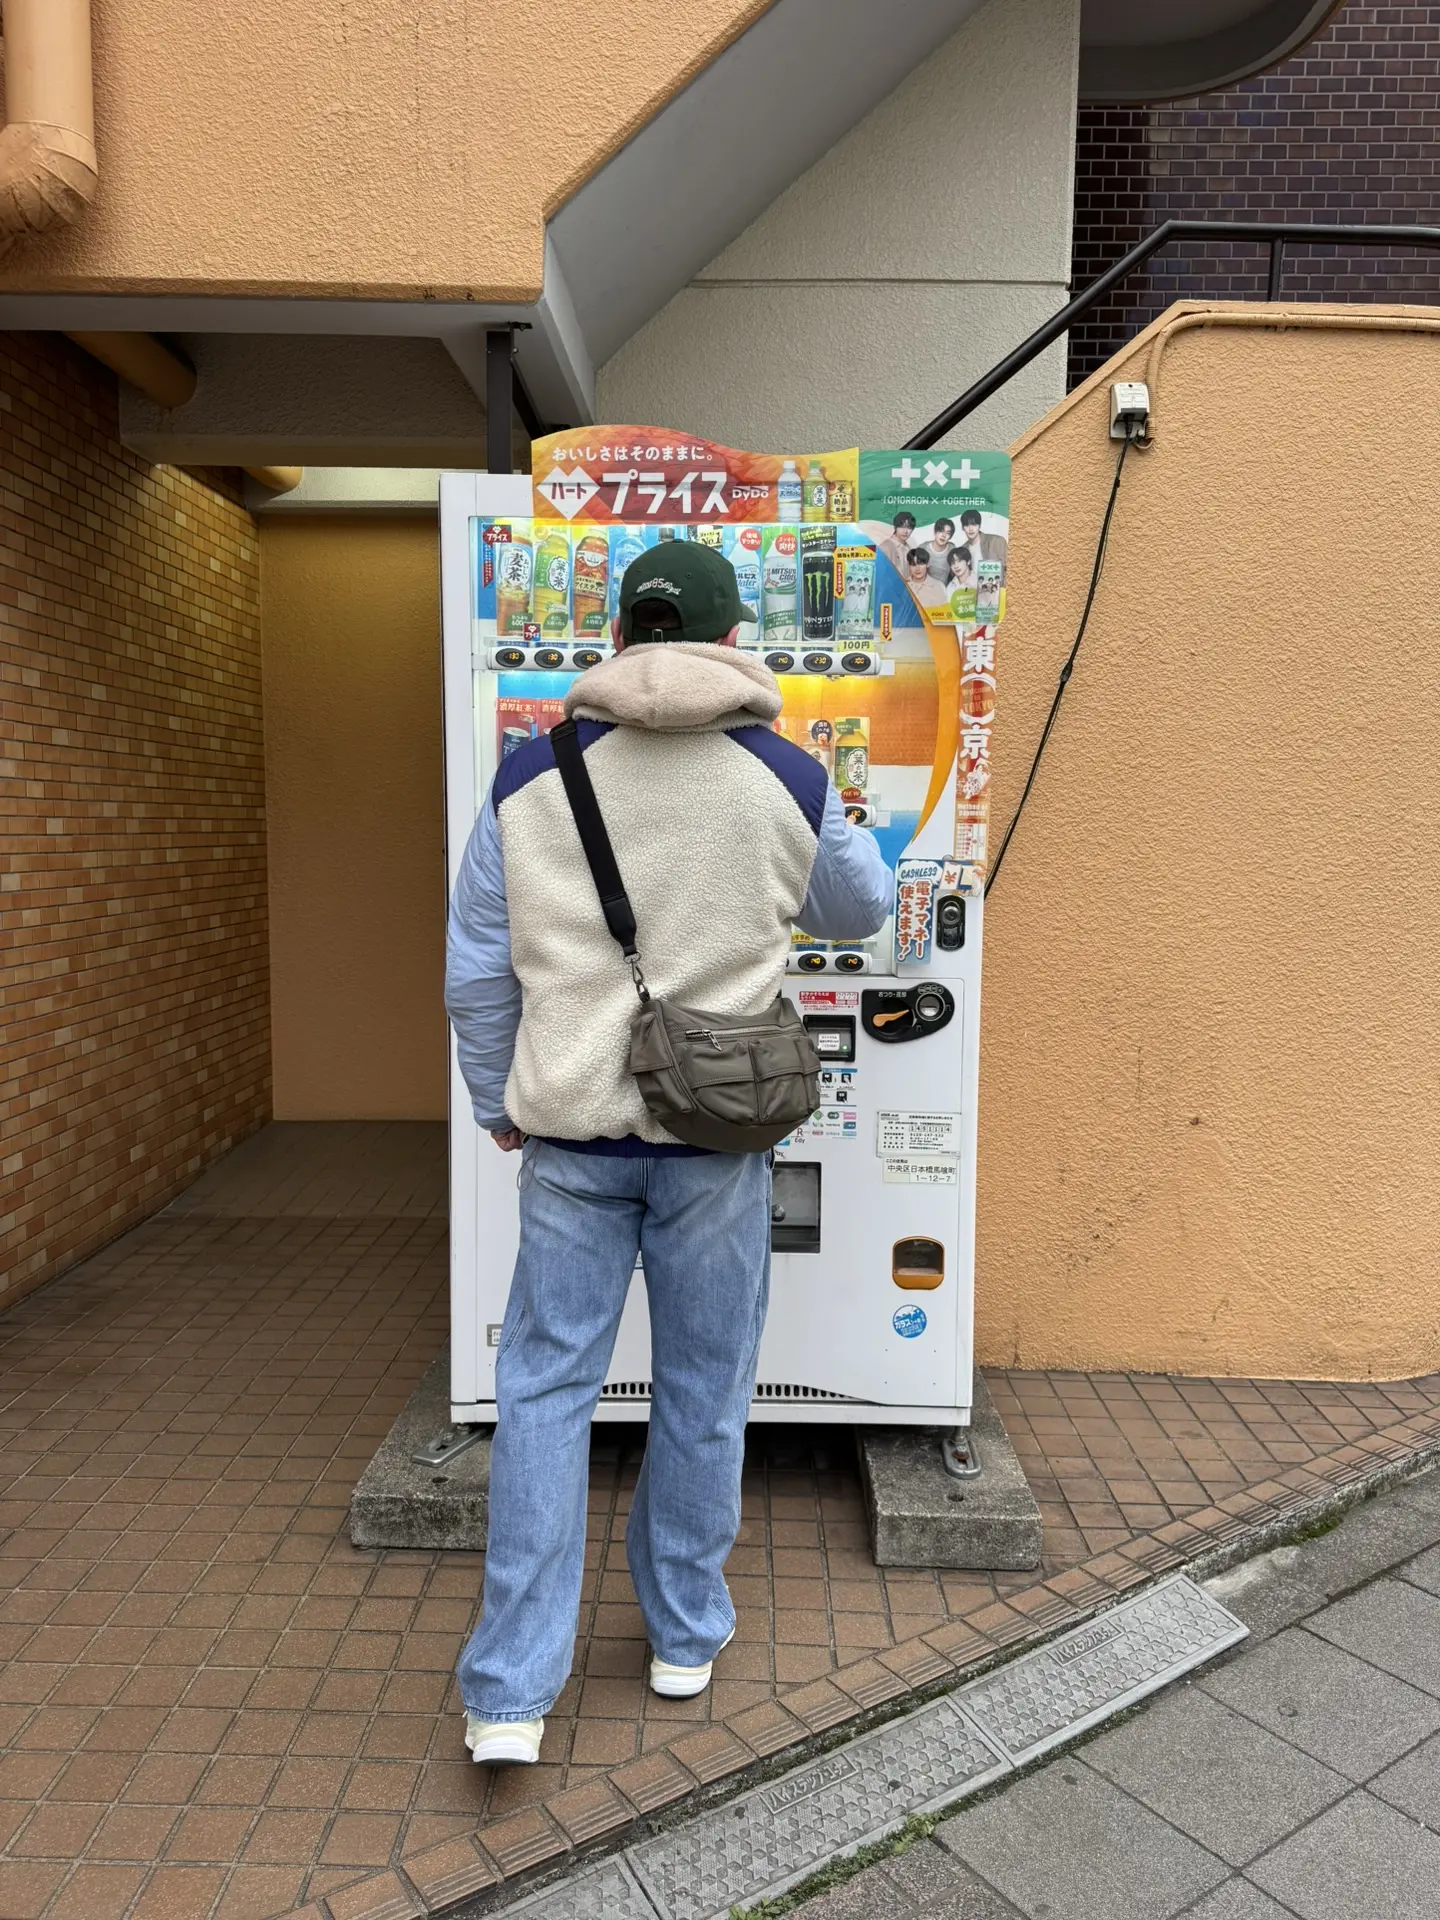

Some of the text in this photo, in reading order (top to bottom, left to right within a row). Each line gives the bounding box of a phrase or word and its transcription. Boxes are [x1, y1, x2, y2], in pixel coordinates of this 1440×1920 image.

[552, 446, 712, 462] おいしさはそのままに。
[551, 468, 730, 515] ハート プライス
[732, 486, 769, 500] DyDo
[508, 552, 523, 582] 麦茶
[843, 640, 870, 650] 100円
[500, 703, 536, 713] 濃厚紅茶!
[853, 753, 864, 782] 葉の茶
[901, 866, 938, 879] CASHLESS
[914, 880, 931, 957] 電子マネー
[888, 1165, 956, 1175] 中央区日本橋馬喰町
